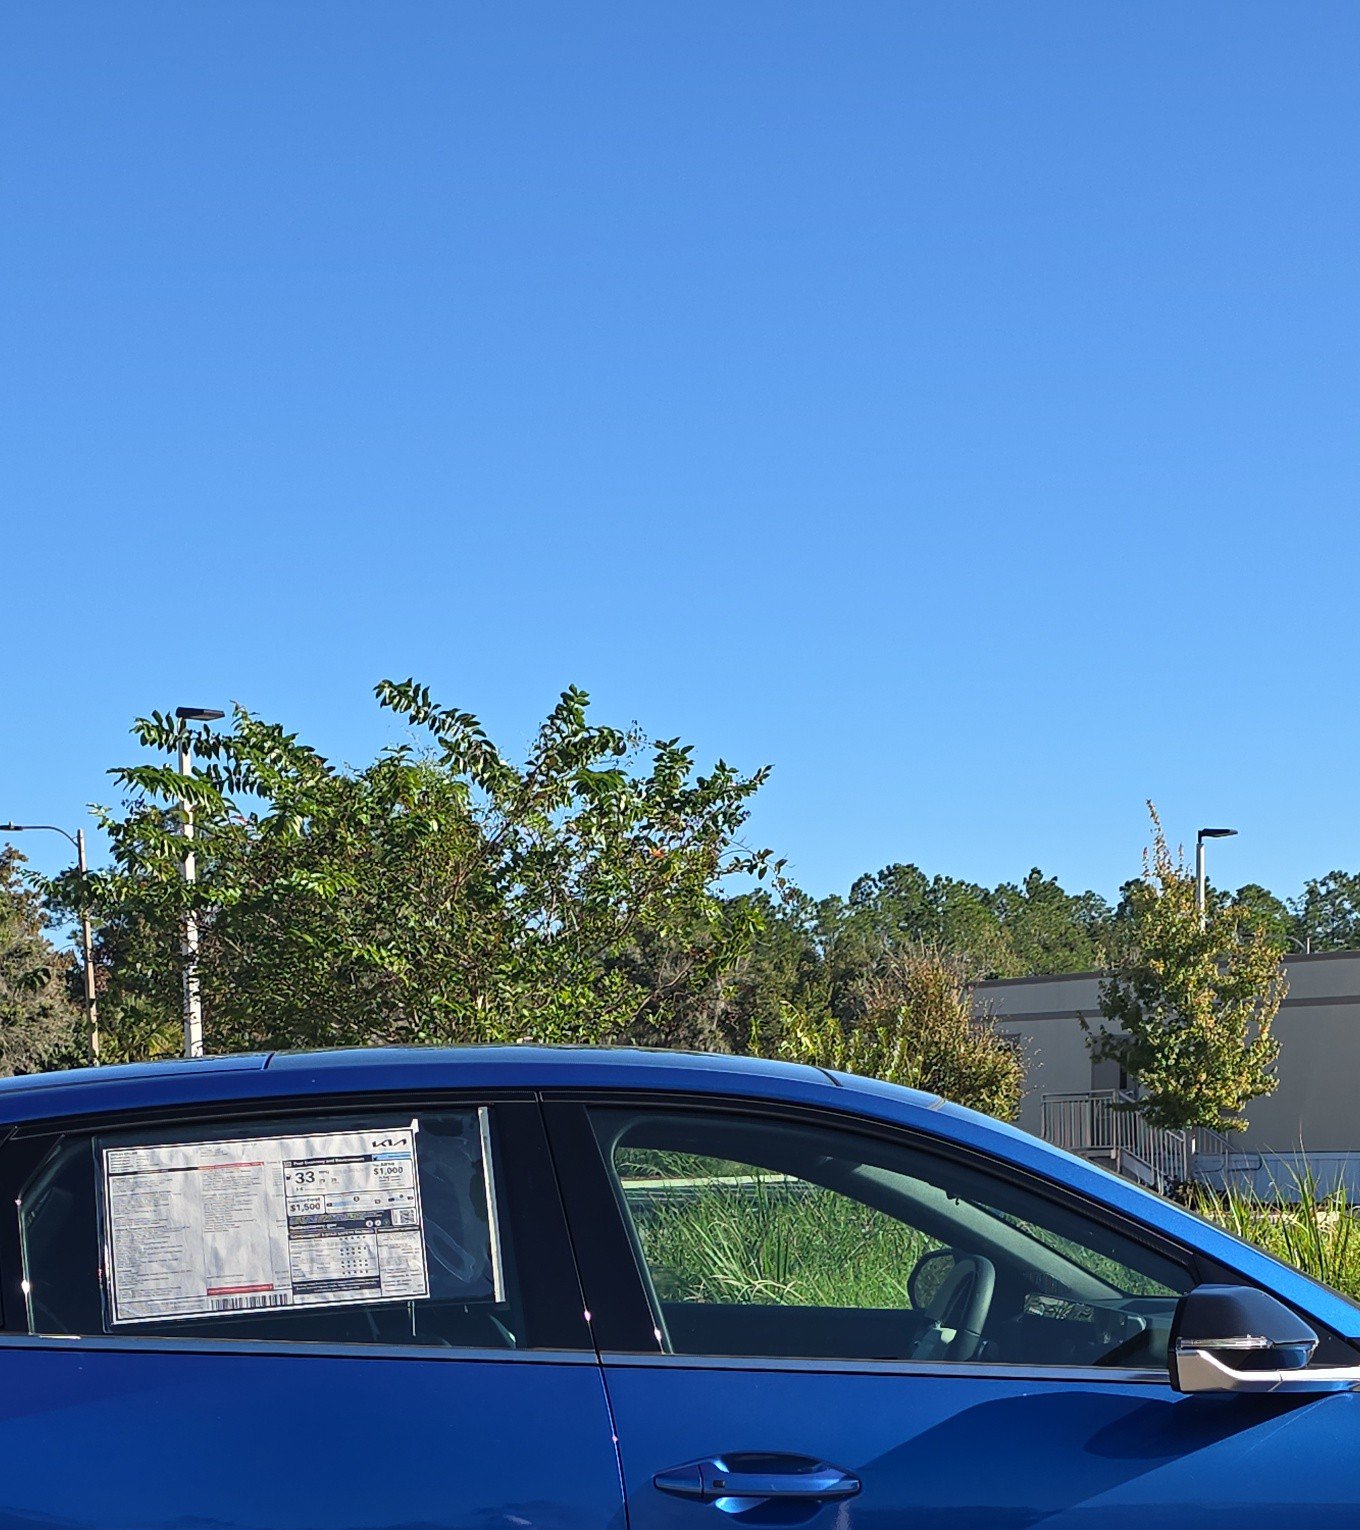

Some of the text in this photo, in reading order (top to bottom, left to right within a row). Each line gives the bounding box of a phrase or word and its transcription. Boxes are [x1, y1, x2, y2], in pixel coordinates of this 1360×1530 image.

[372, 1138, 407, 1148] KIA
[373, 1166, 404, 1176] $1,000
[294, 1171, 316, 1184] 33
[289, 1202, 321, 1212] $1,500
